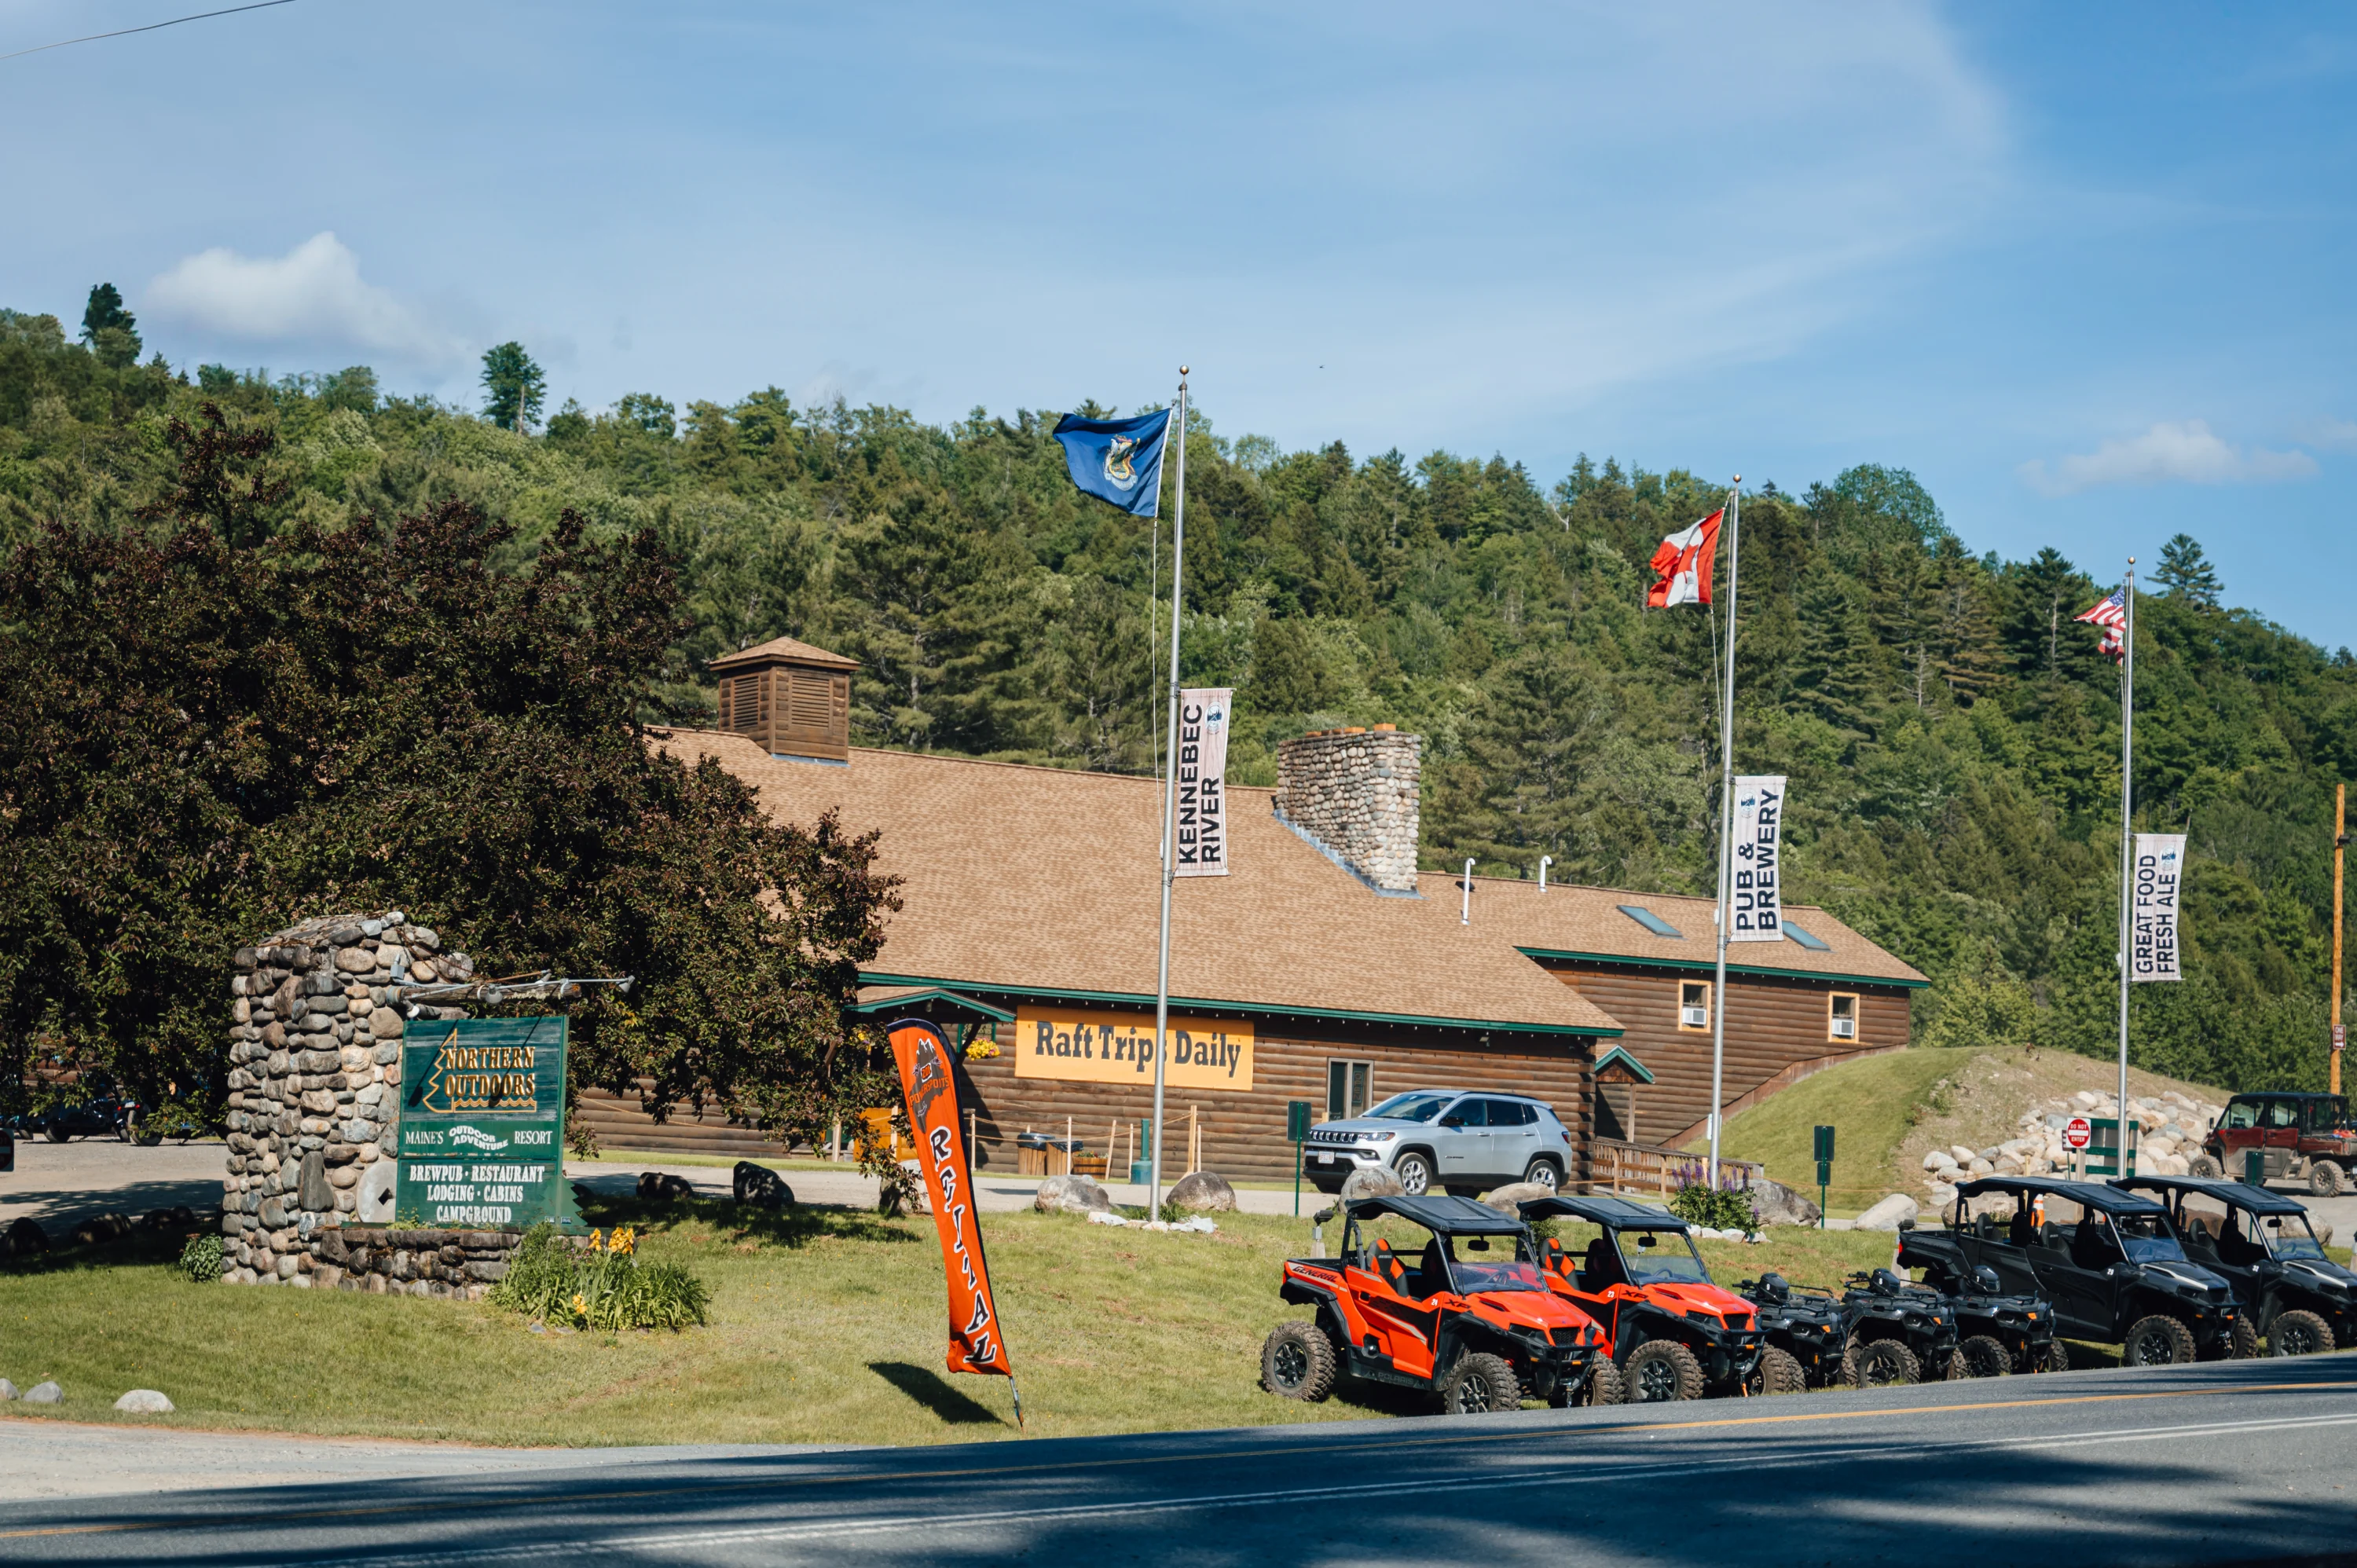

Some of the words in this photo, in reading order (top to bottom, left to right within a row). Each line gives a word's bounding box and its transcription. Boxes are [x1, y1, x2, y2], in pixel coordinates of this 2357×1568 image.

[1178, 704, 1203, 864] KENNEBEC
[1201, 777, 1221, 863] RIVER
[1738, 841, 1754, 860] &
[1757, 788, 1780, 930] BREWERY
[2137, 855, 2157, 907] FOOD
[2156, 874, 2176, 907] ALE
[1736, 869, 1755, 930] PUB
[2136, 912, 2154, 973] GREAT
[2156, 914, 2176, 973] FRESH
[445, 1046, 536, 1070] NORTHERN
[1036, 1021, 1093, 1060] Raft
[1098, 1024, 1168, 1073] Trip
[1175, 1030, 1241, 1078] Daily
[444, 1072, 536, 1097] OUTDOORS
[909, 1077, 950, 1107] PORSPOTS
[405, 1130, 444, 1145] MAINE'S
[515, 1130, 553, 1145] RESORT
[449, 1125, 496, 1143] OUTDOOR
[453, 1135, 508, 1151] ADVENTURE
[409, 1164, 464, 1181] BREWPUB
[471, 1165, 545, 1182] RESTAURANT
[427, 1185, 475, 1202] LODGING
[483, 1185, 523, 1202] CABINS
[436, 1205, 511, 1223] CAMPGROUND
[1292, 1266, 1336, 1282] GENERAL
[1444, 1299, 1471, 1309] XP
[1622, 1290, 1648, 1299] XP
[1378, 1372, 1413, 1384] POLARIS
